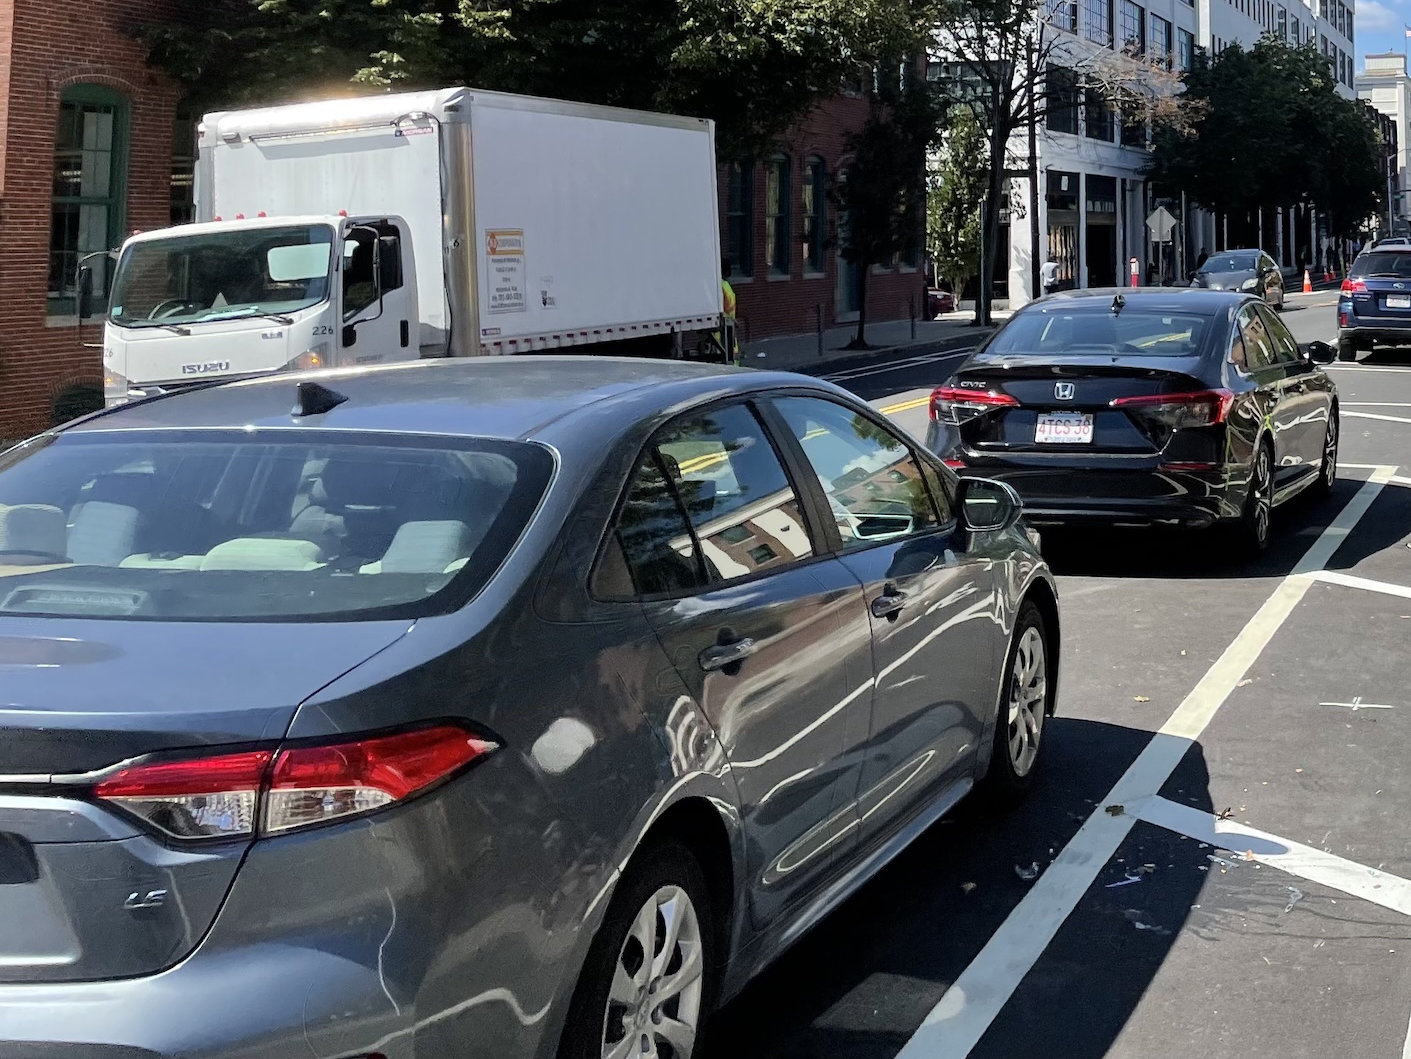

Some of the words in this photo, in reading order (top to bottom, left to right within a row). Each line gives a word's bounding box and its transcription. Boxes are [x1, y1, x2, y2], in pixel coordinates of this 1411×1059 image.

[312, 325, 334, 336] 226
[104, 348, 114, 358] 26
[182, 362, 230, 375] ISUZU
[1038, 419, 1071, 435] 4TCS
[124, 889, 168, 910] LE
